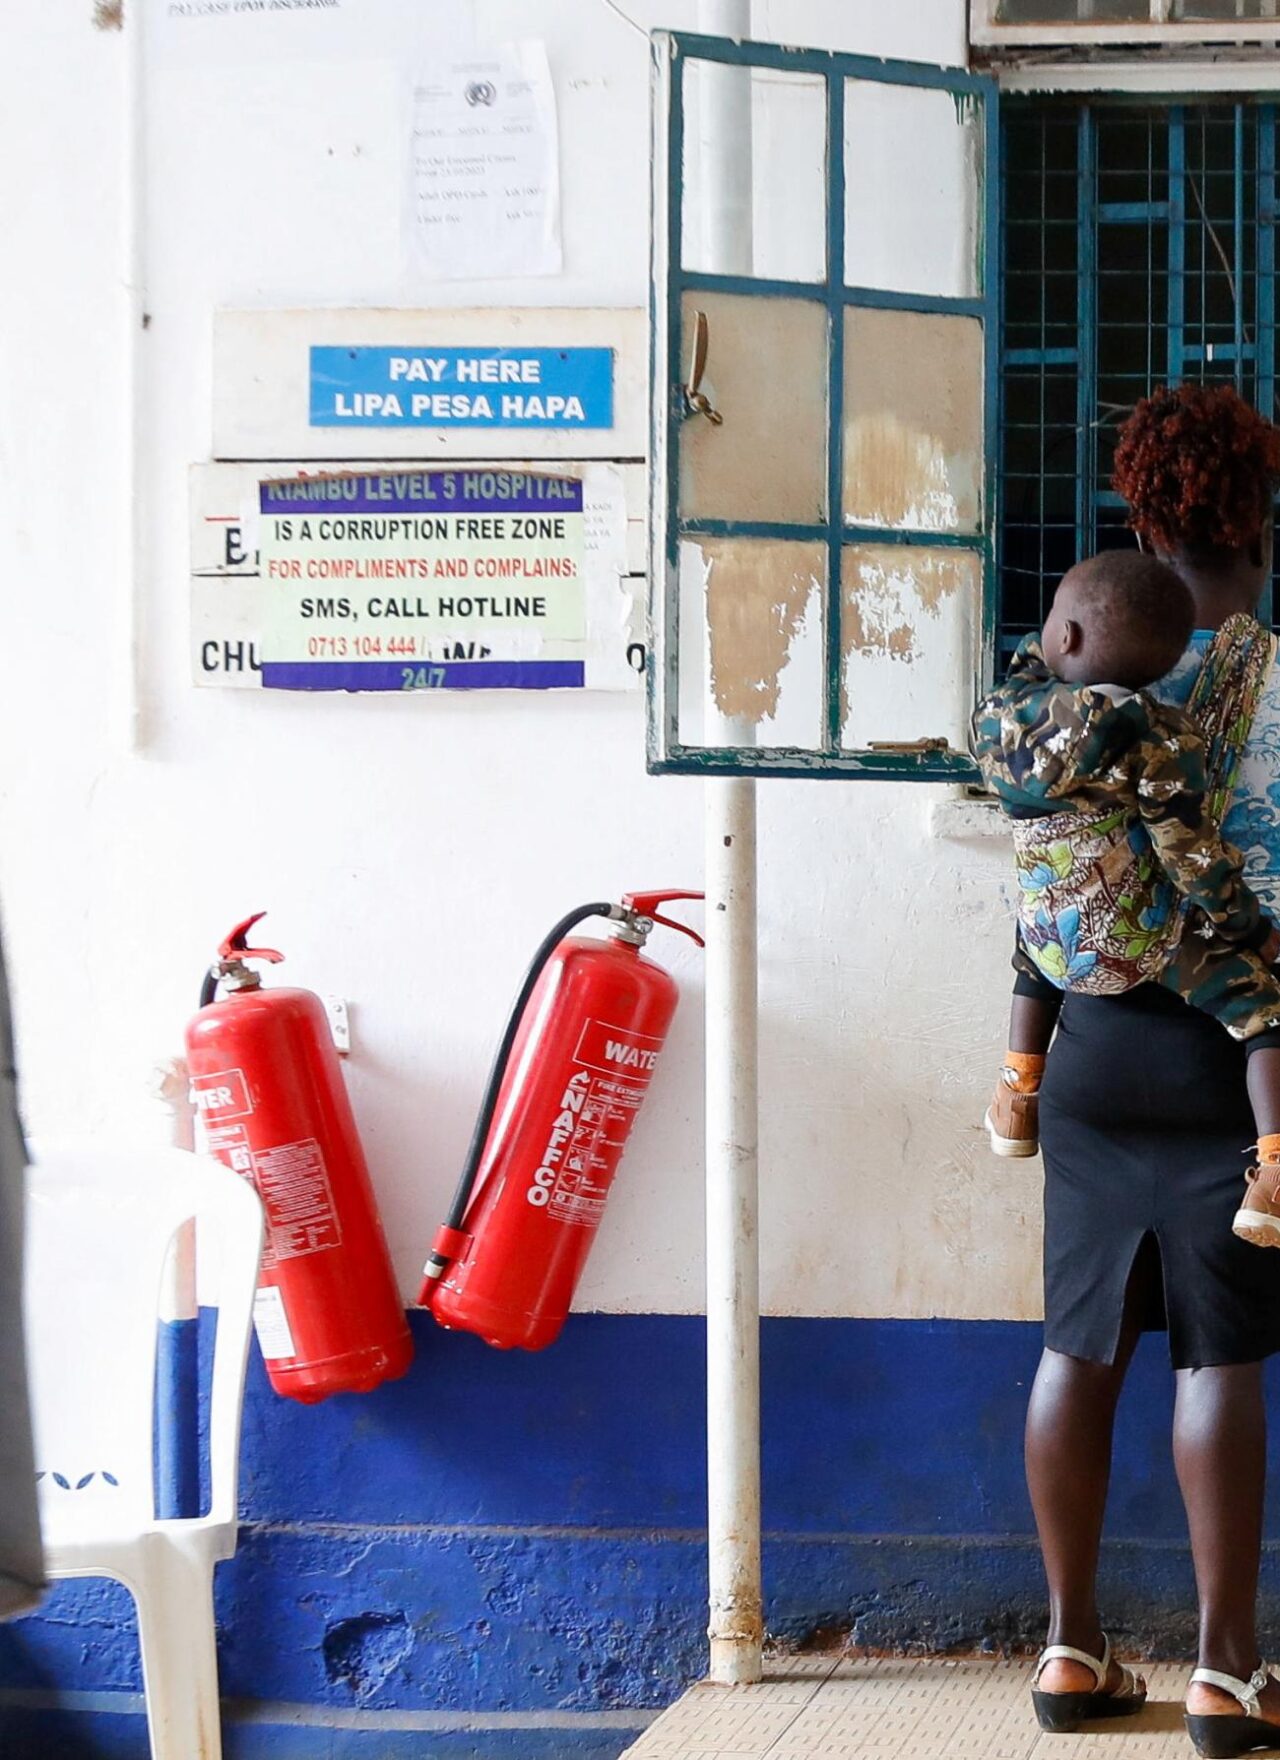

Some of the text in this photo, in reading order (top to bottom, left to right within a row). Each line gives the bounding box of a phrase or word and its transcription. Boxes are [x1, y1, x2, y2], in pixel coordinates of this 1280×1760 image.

[389, 358, 541, 383] PAY HERE
[335, 393, 586, 421] LIPA PESA HAPA
[365, 475, 436, 501] LEVEL
[444, 473, 456, 500] 5
[463, 472, 576, 500] HOSPITAL
[275, 518, 565, 541] IS A CORRUPTION FREE ZONE
[268, 557, 577, 579] FOR COMPLIMENTS AND COMPLAINS:
[300, 597, 546, 622] SMS, CALL HOTLINE
[308, 636, 348, 656] 0713
[354, 635, 381, 657] 104
[387, 635, 416, 656] 444
[402, 667, 447, 688] 24/7
[605, 1040, 657, 1070] WATE
[527, 1089, 586, 1206] NAFFCO
